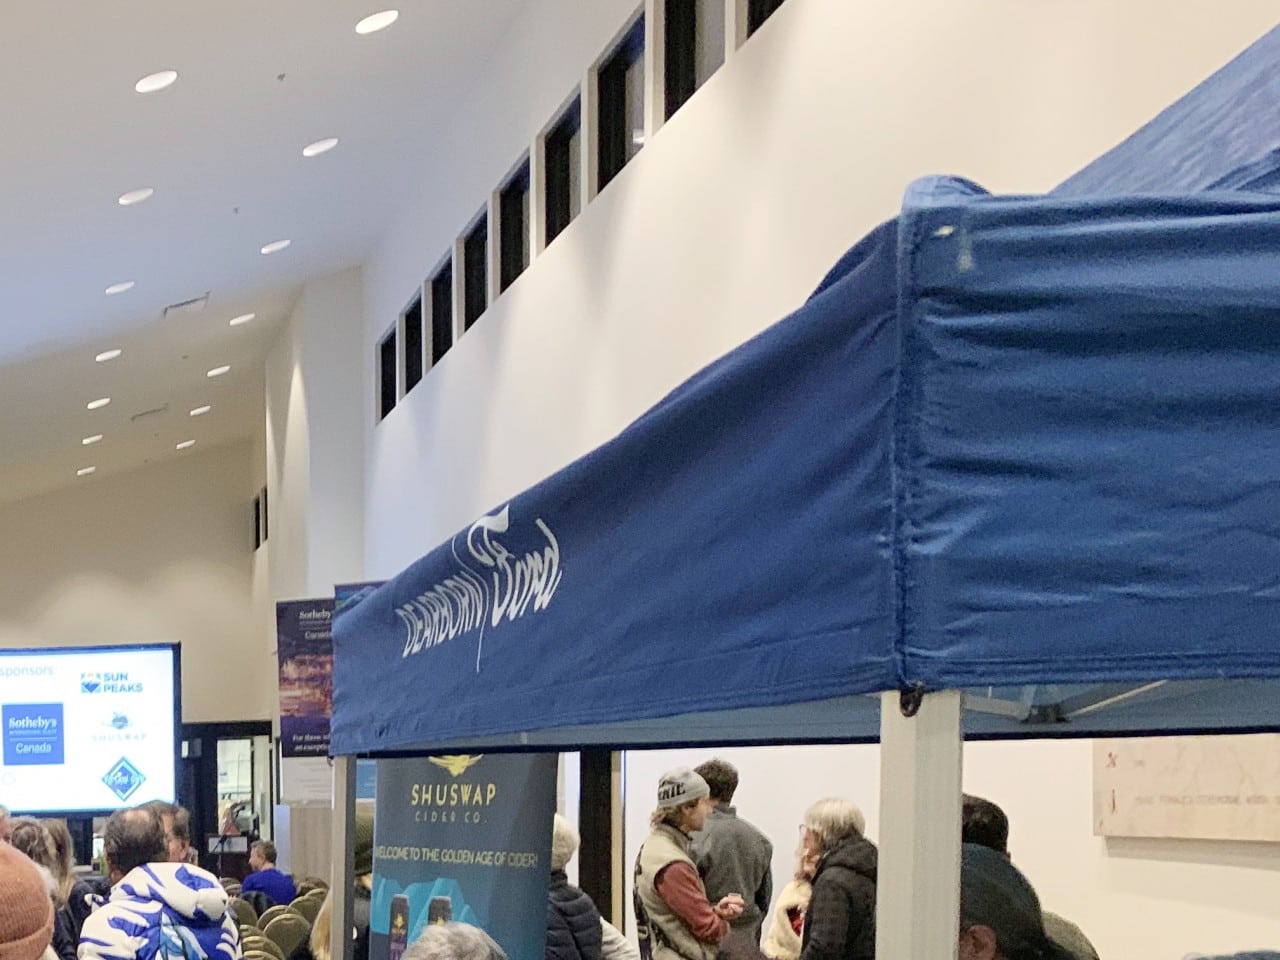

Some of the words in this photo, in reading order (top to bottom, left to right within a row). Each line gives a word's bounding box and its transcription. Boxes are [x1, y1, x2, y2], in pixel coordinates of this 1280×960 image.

[395, 570, 483, 658] DEARBORN
[0, 664, 54, 681] sponsors
[103, 672, 128, 682] SUN
[103, 682, 143, 693] PEAKS
[8, 715, 57, 730] Sotheby's
[16, 742, 52, 755] Canada
[410, 783, 497, 807] SHUSWAP
[415, 811, 456, 823] CIDER
[464, 811, 488, 823] CO.
[409, 846, 420, 860] TO
[422, 847, 440, 861] THE
[440, 849, 474, 864] GOLDEN
[474, 850, 494, 866] AGE
[494, 851, 506, 866] OF
